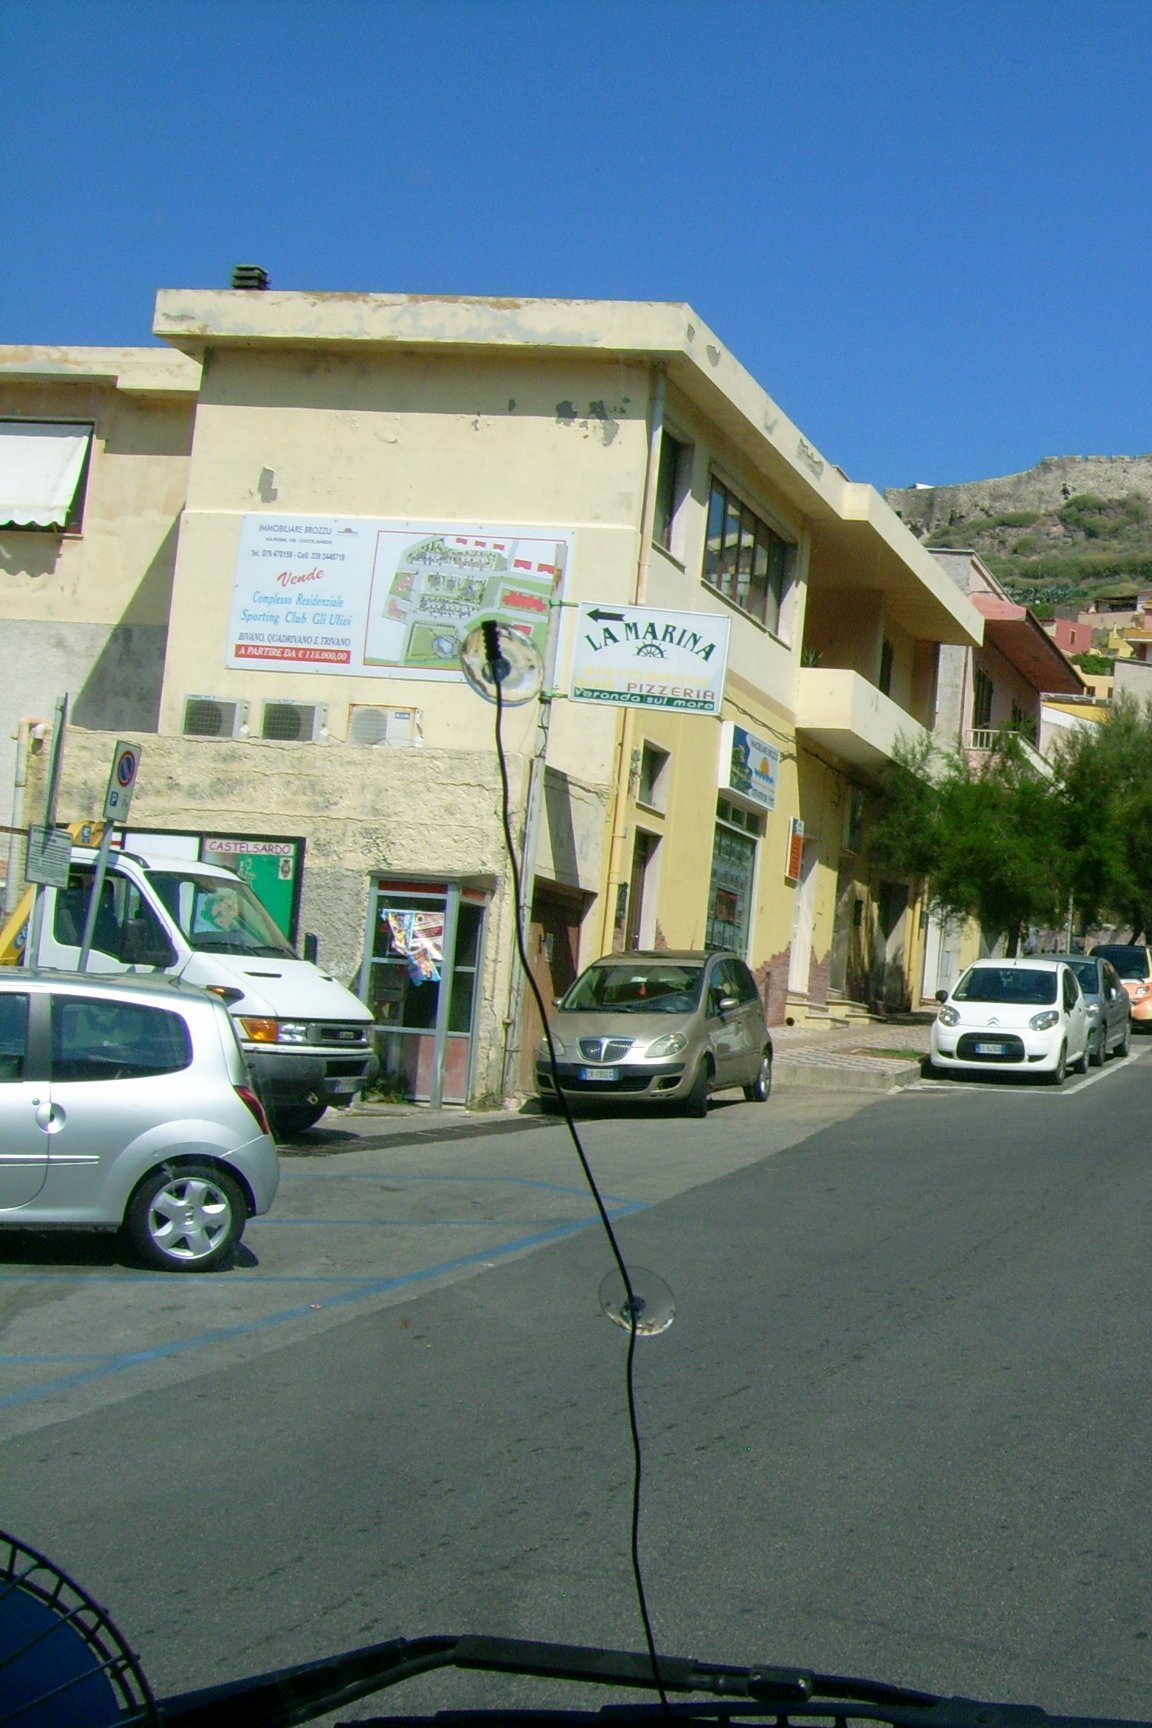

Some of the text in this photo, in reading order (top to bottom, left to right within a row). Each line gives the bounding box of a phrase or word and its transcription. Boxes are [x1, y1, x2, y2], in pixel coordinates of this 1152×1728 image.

[259, 524, 332, 535] IMMOBILIARE BROZZU
[277, 566, 325, 587] Vende
[252, 590, 345, 608] Complesso Residenziale
[240, 608, 280, 625] Sporting
[285, 611, 307, 624] Club
[312, 612, 326, 625] Gli
[267, 633, 312, 645] QUADRIVANO
[313, 636, 319, 645] E
[320, 637, 351, 647] TRIVANO
[585, 622, 716, 662] LA MARINA
[247, 647, 282, 657] PARTIRE
[283, 649, 296, 658] DA
[575, 688, 714, 710] Veranda sul mare
[627, 682, 715, 700] PIZZERIA
[209, 841, 291, 854] CASTELSARDO
